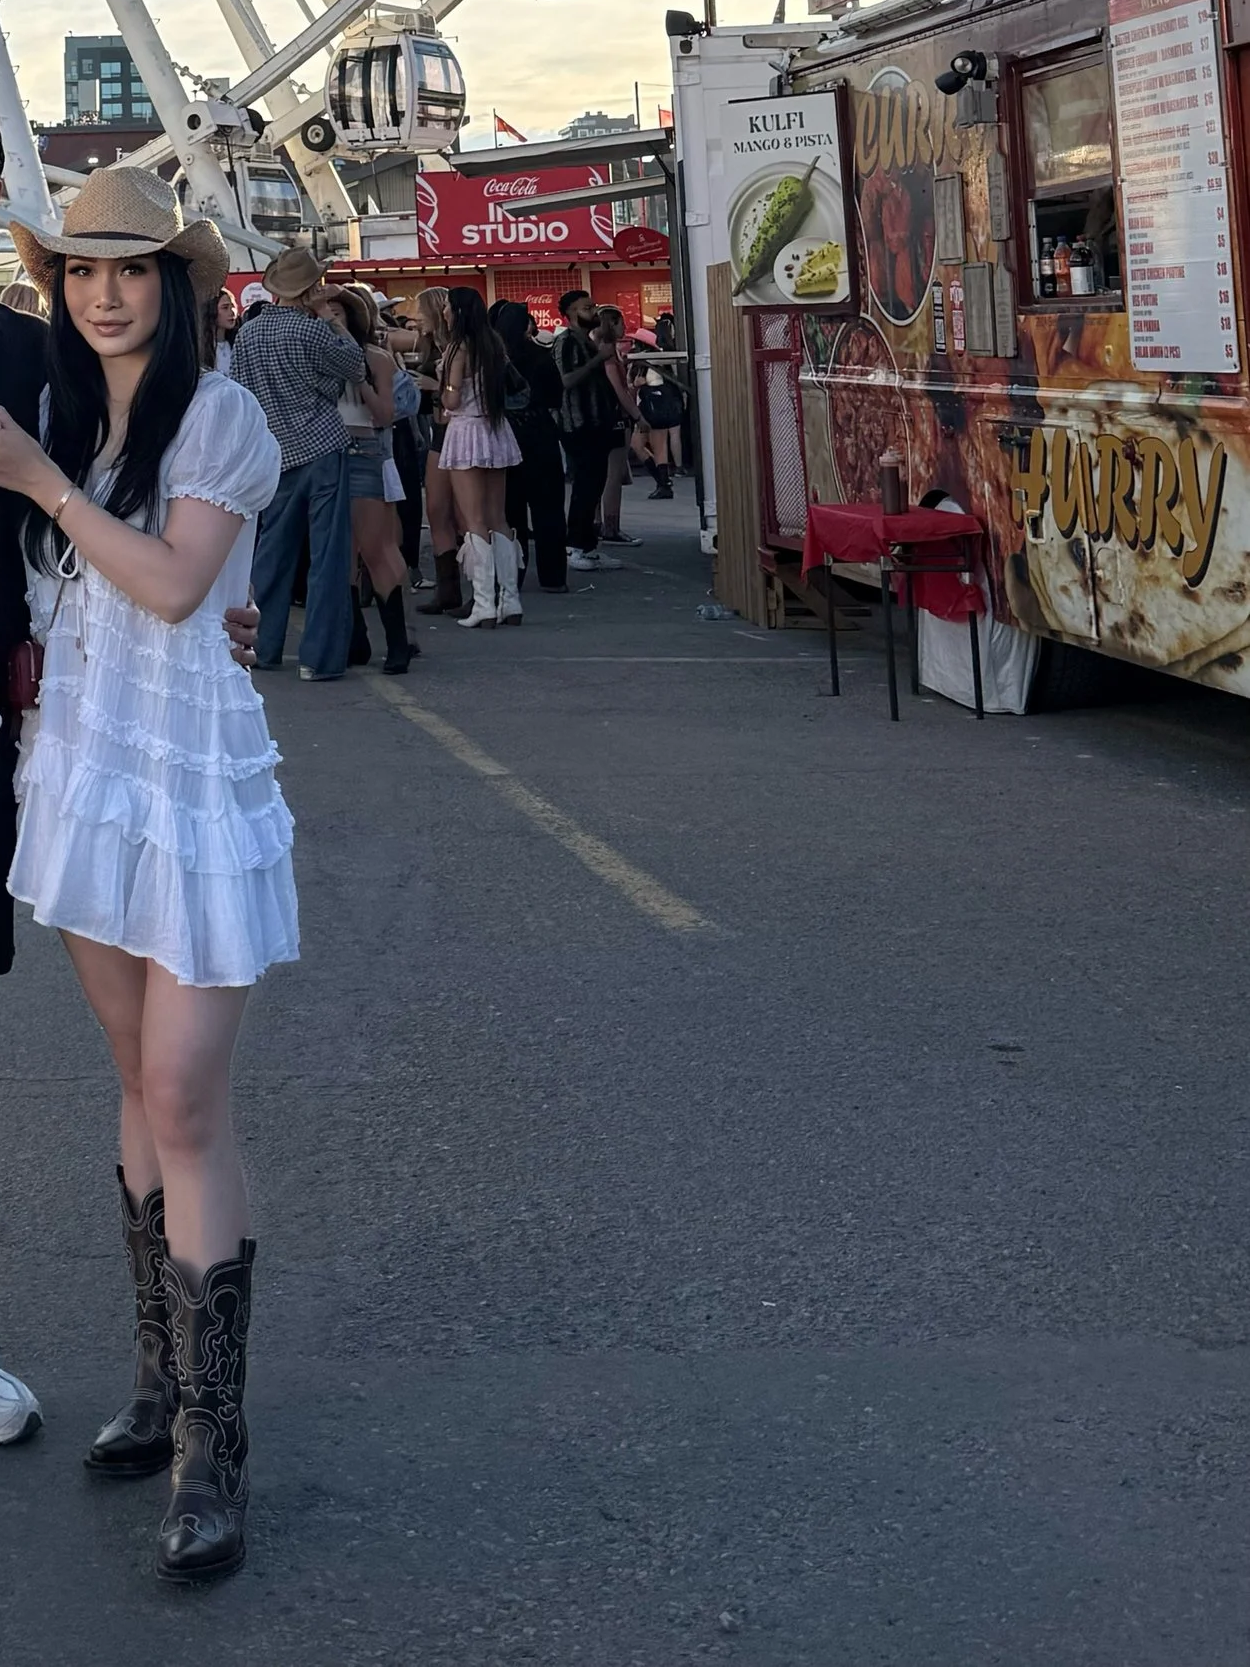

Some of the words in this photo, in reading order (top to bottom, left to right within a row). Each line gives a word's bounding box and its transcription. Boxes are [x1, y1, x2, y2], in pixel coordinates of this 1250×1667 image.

[748, 112, 805, 133] KULFI
[734, 138, 781, 153] MANGO
[783, 137, 792, 149] &
[795, 133, 833, 148] PISTA
[483, 176, 541, 197] Coca-Cola
[462, 221, 569, 246] STUDIO
[530, 309, 551, 319] INK
[1011, 427, 1228, 590] HURRY
